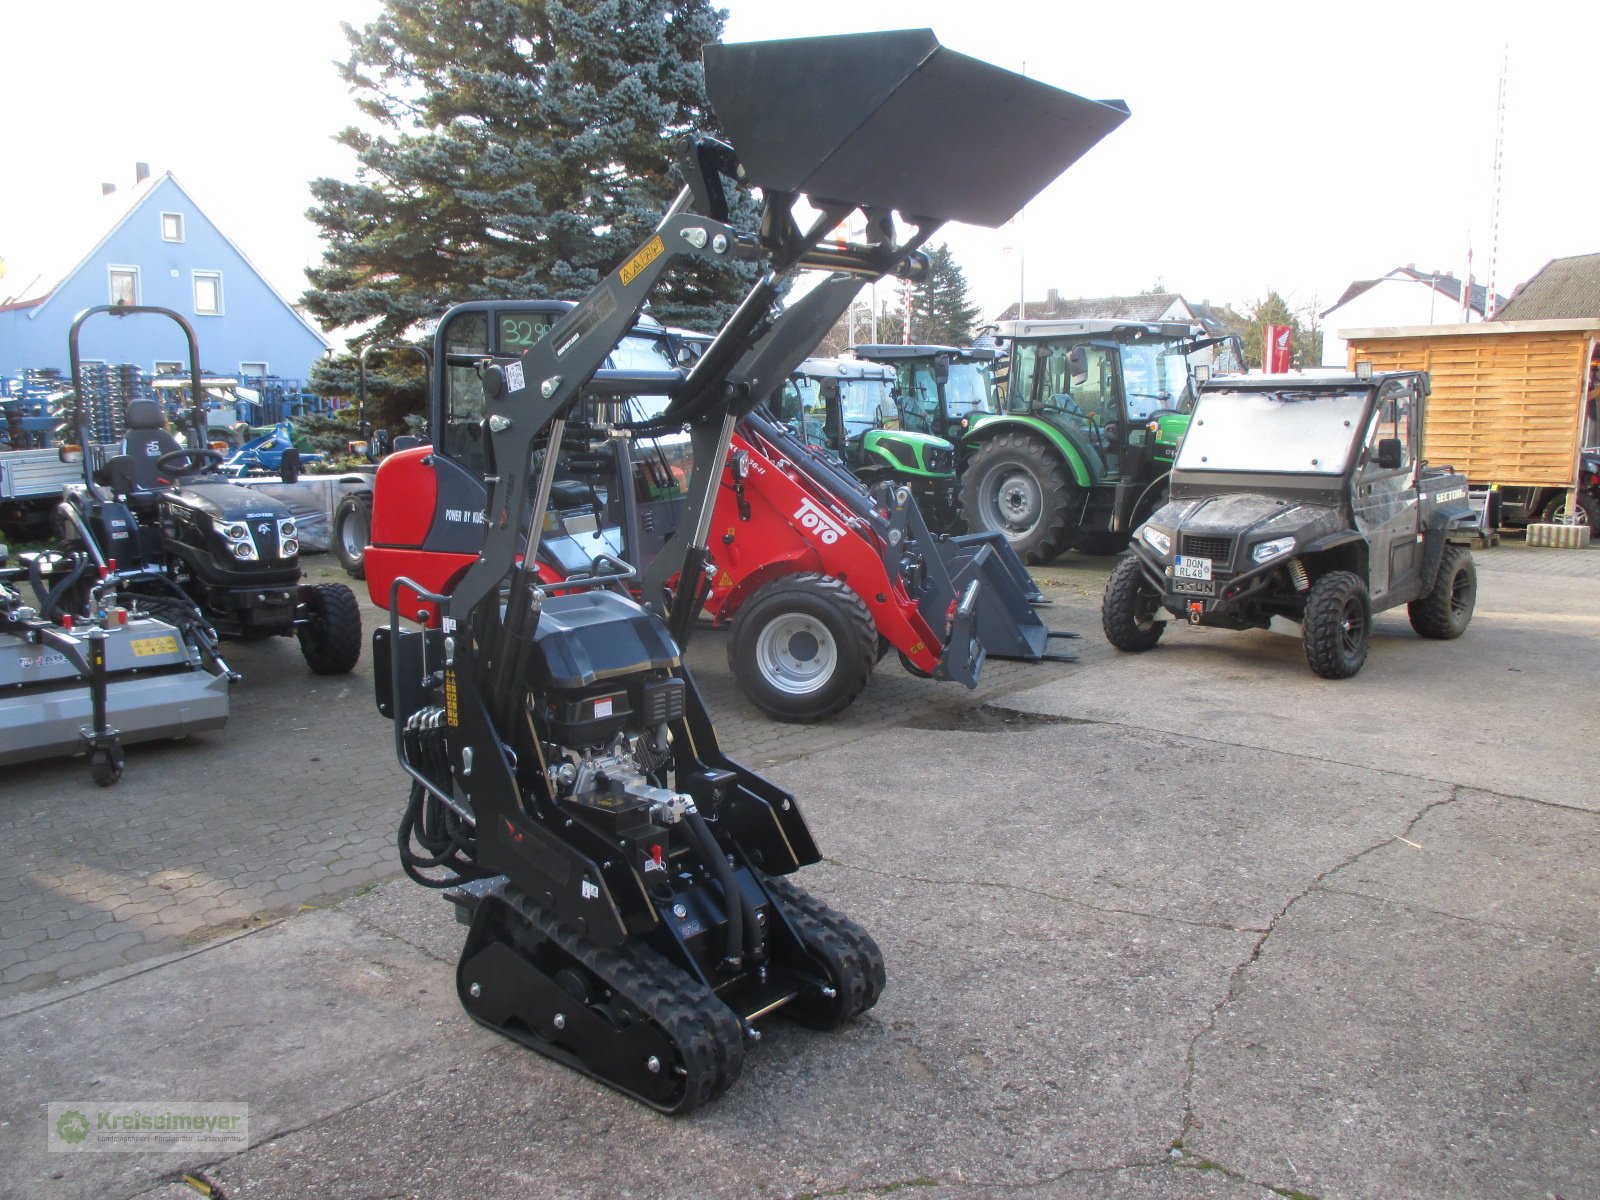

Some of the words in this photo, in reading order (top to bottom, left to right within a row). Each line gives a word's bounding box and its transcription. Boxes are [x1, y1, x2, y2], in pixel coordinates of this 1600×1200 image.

[445, 509, 462, 522] POWER
[463, 511, 471, 523] BY
[793, 497, 847, 545] TOYO
[1186, 558, 1204, 569] DON
[1179, 567, 1191, 577] RL
[1192, 569, 1203, 578] 48
